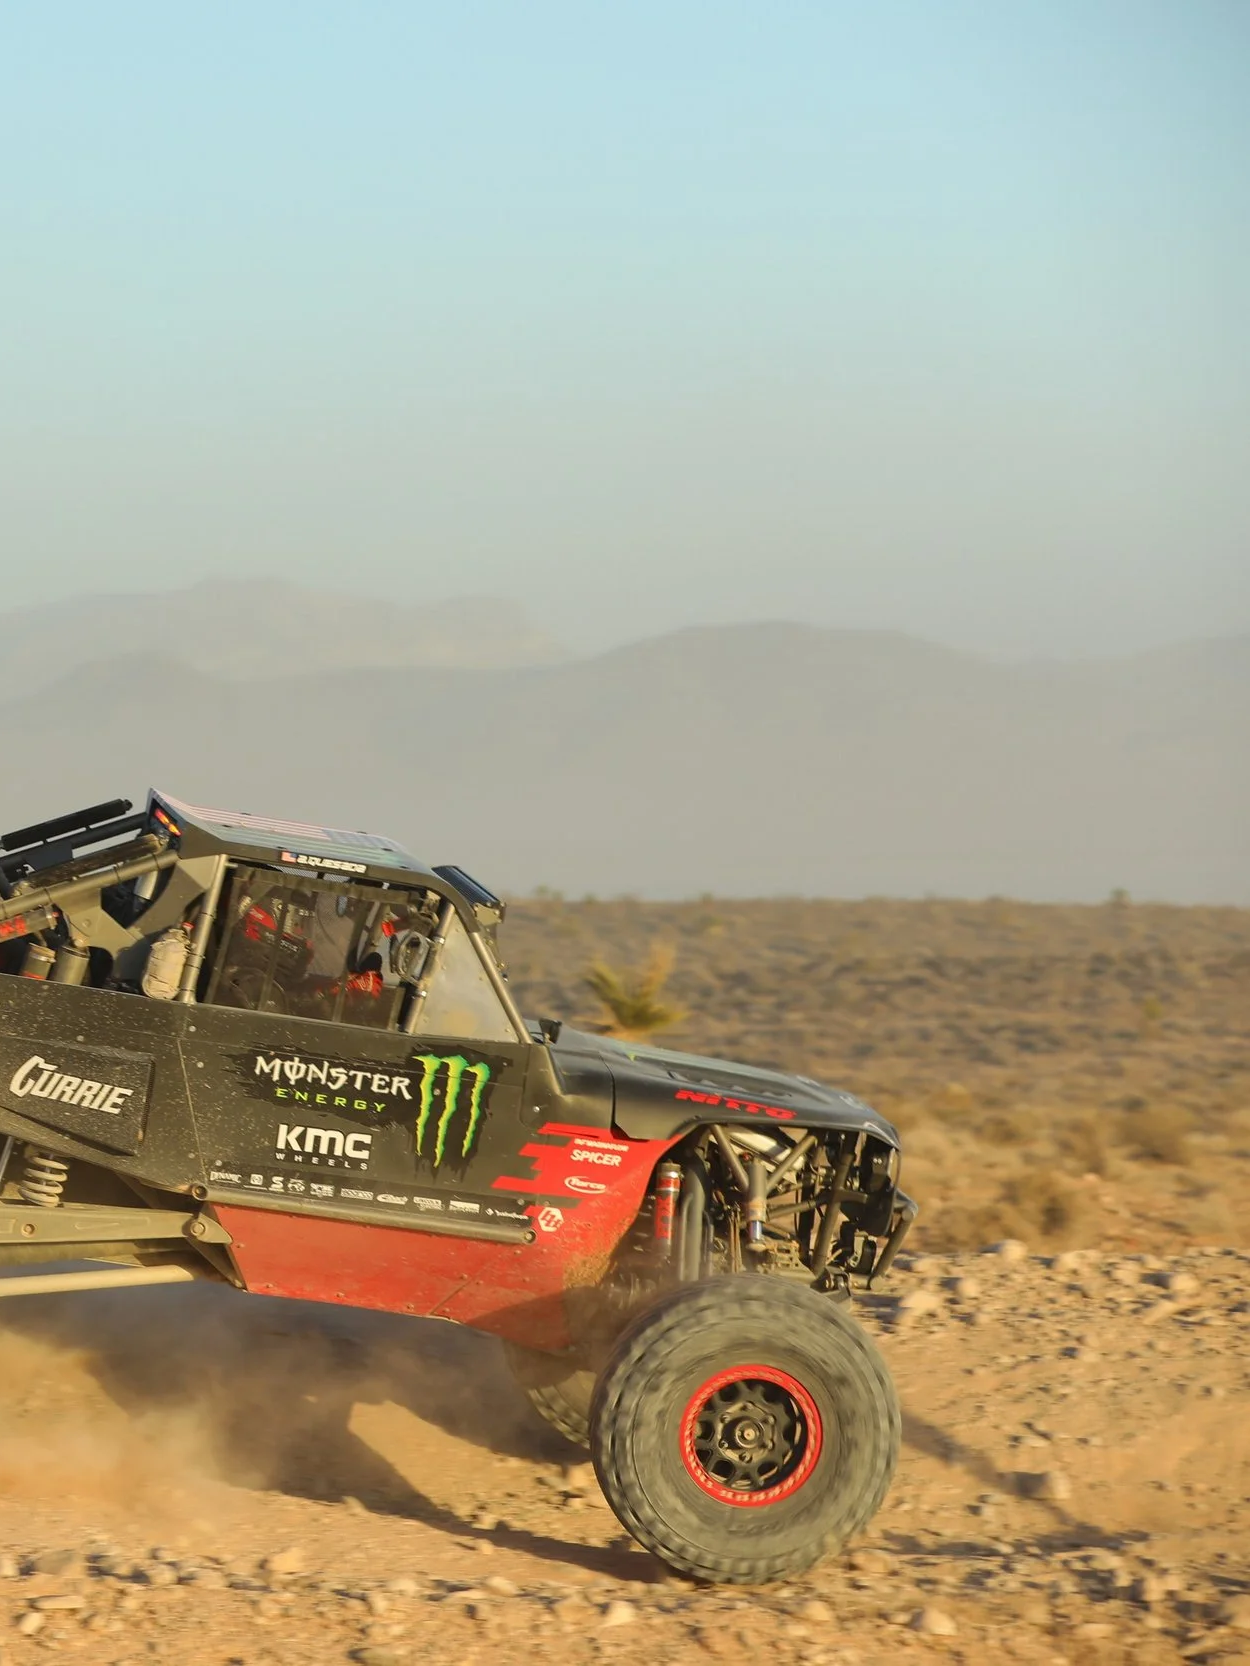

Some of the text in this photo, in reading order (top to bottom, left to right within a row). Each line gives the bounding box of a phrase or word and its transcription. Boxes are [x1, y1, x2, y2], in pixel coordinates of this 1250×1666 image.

[254, 1056, 413, 1100] MONSTER
[275, 1088, 386, 1113] ENERGY
[674, 1088, 798, 1119] NITTO
[276, 1124, 373, 1160] KMC
[275, 1152, 369, 1171] WHEELS
[570, 1149, 622, 1167] SPICER
